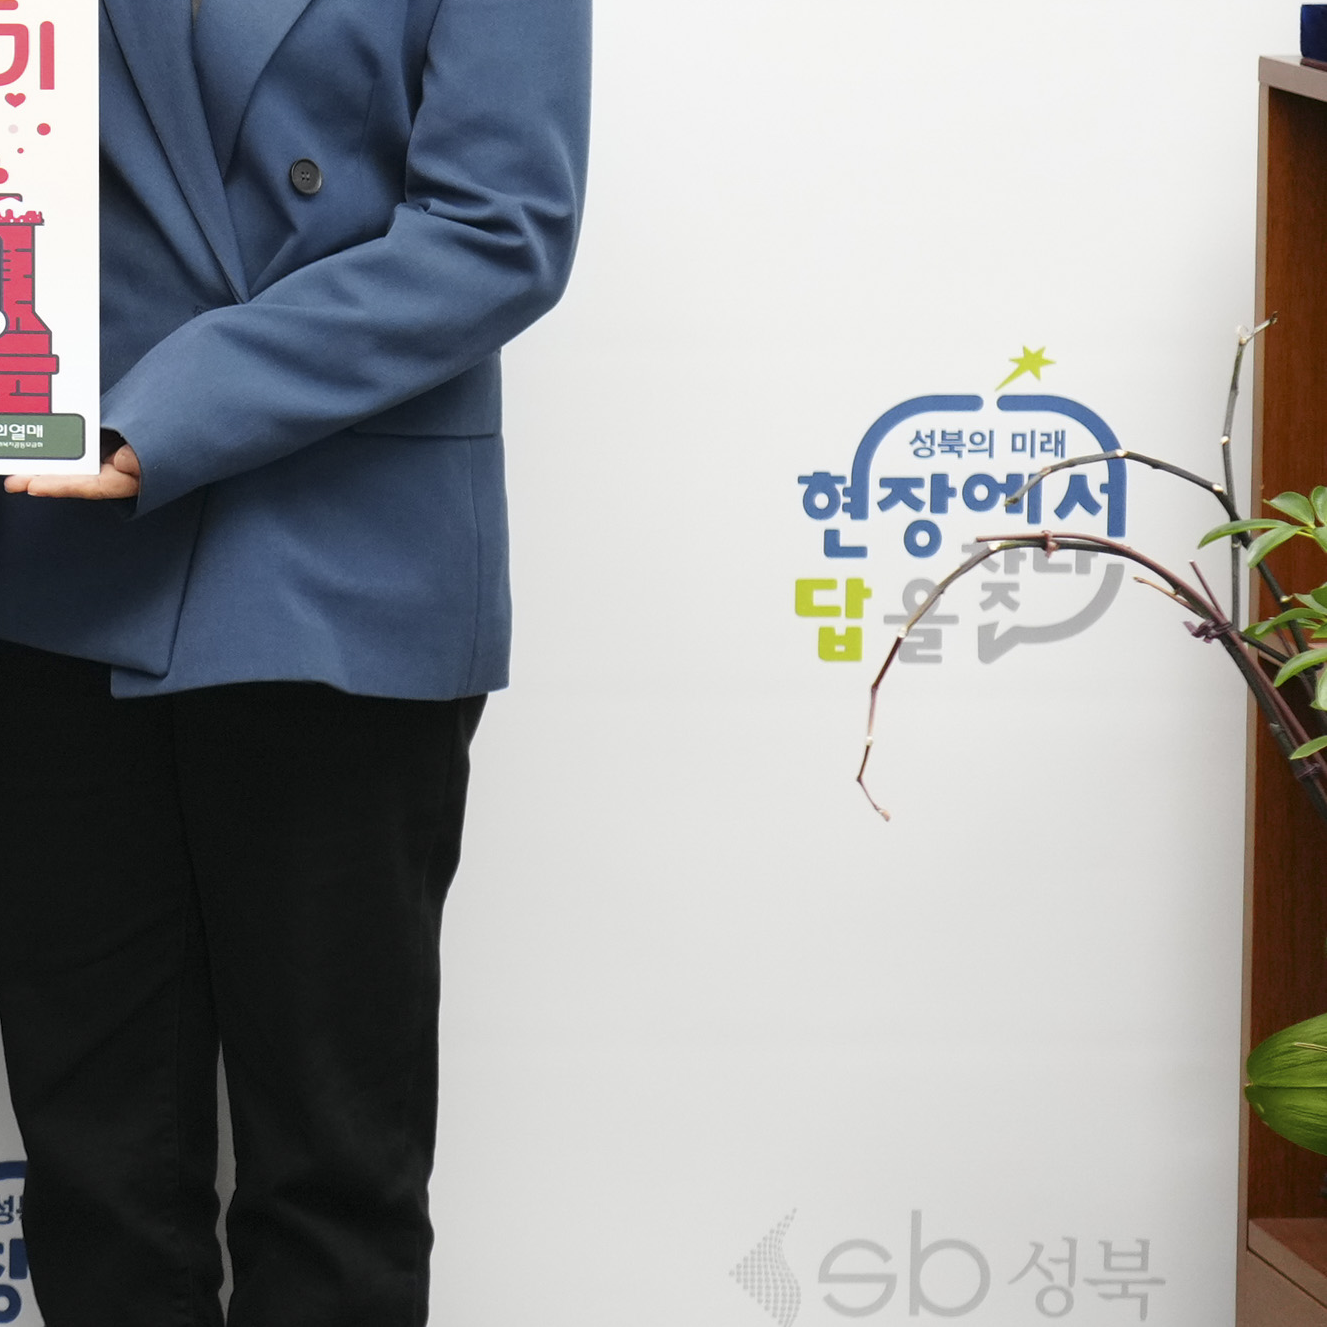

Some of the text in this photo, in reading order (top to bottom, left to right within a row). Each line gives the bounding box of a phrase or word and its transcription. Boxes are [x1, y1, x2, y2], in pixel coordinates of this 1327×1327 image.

[909, 429, 1066, 459] 성북의 미래
[798, 470, 1127, 559] 현장에서
[818, 1209, 1166, 1321] sb 성북
